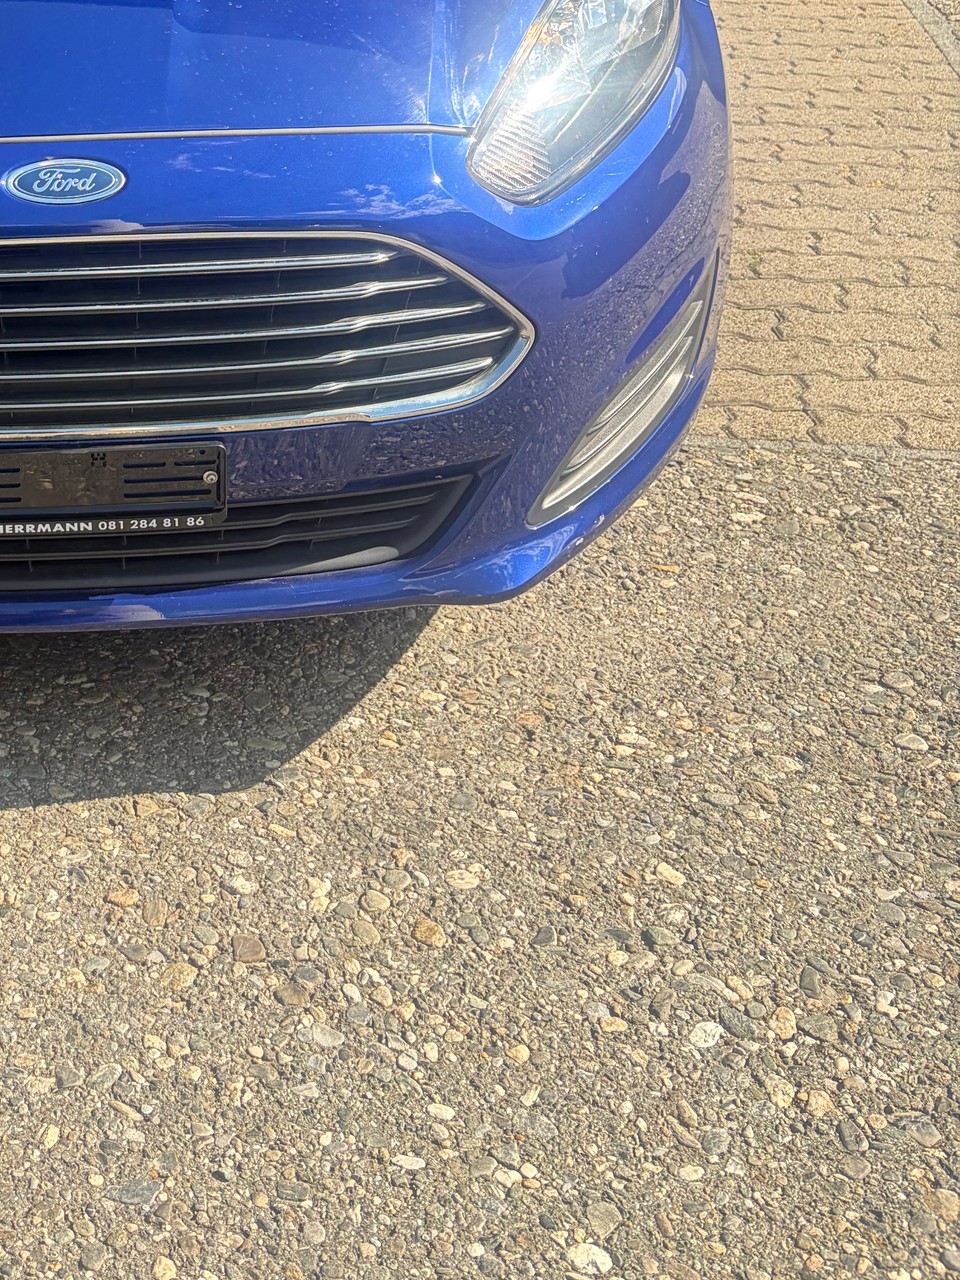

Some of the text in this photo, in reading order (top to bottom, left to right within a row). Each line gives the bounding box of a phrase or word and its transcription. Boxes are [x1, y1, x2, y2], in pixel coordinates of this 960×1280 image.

[32, 168, 96, 193] Ford
[98, 520, 125, 531] 081
[130, 518, 158, 529] 284
[163, 517, 180, 528] 81
[186, 516, 205, 527] 86
